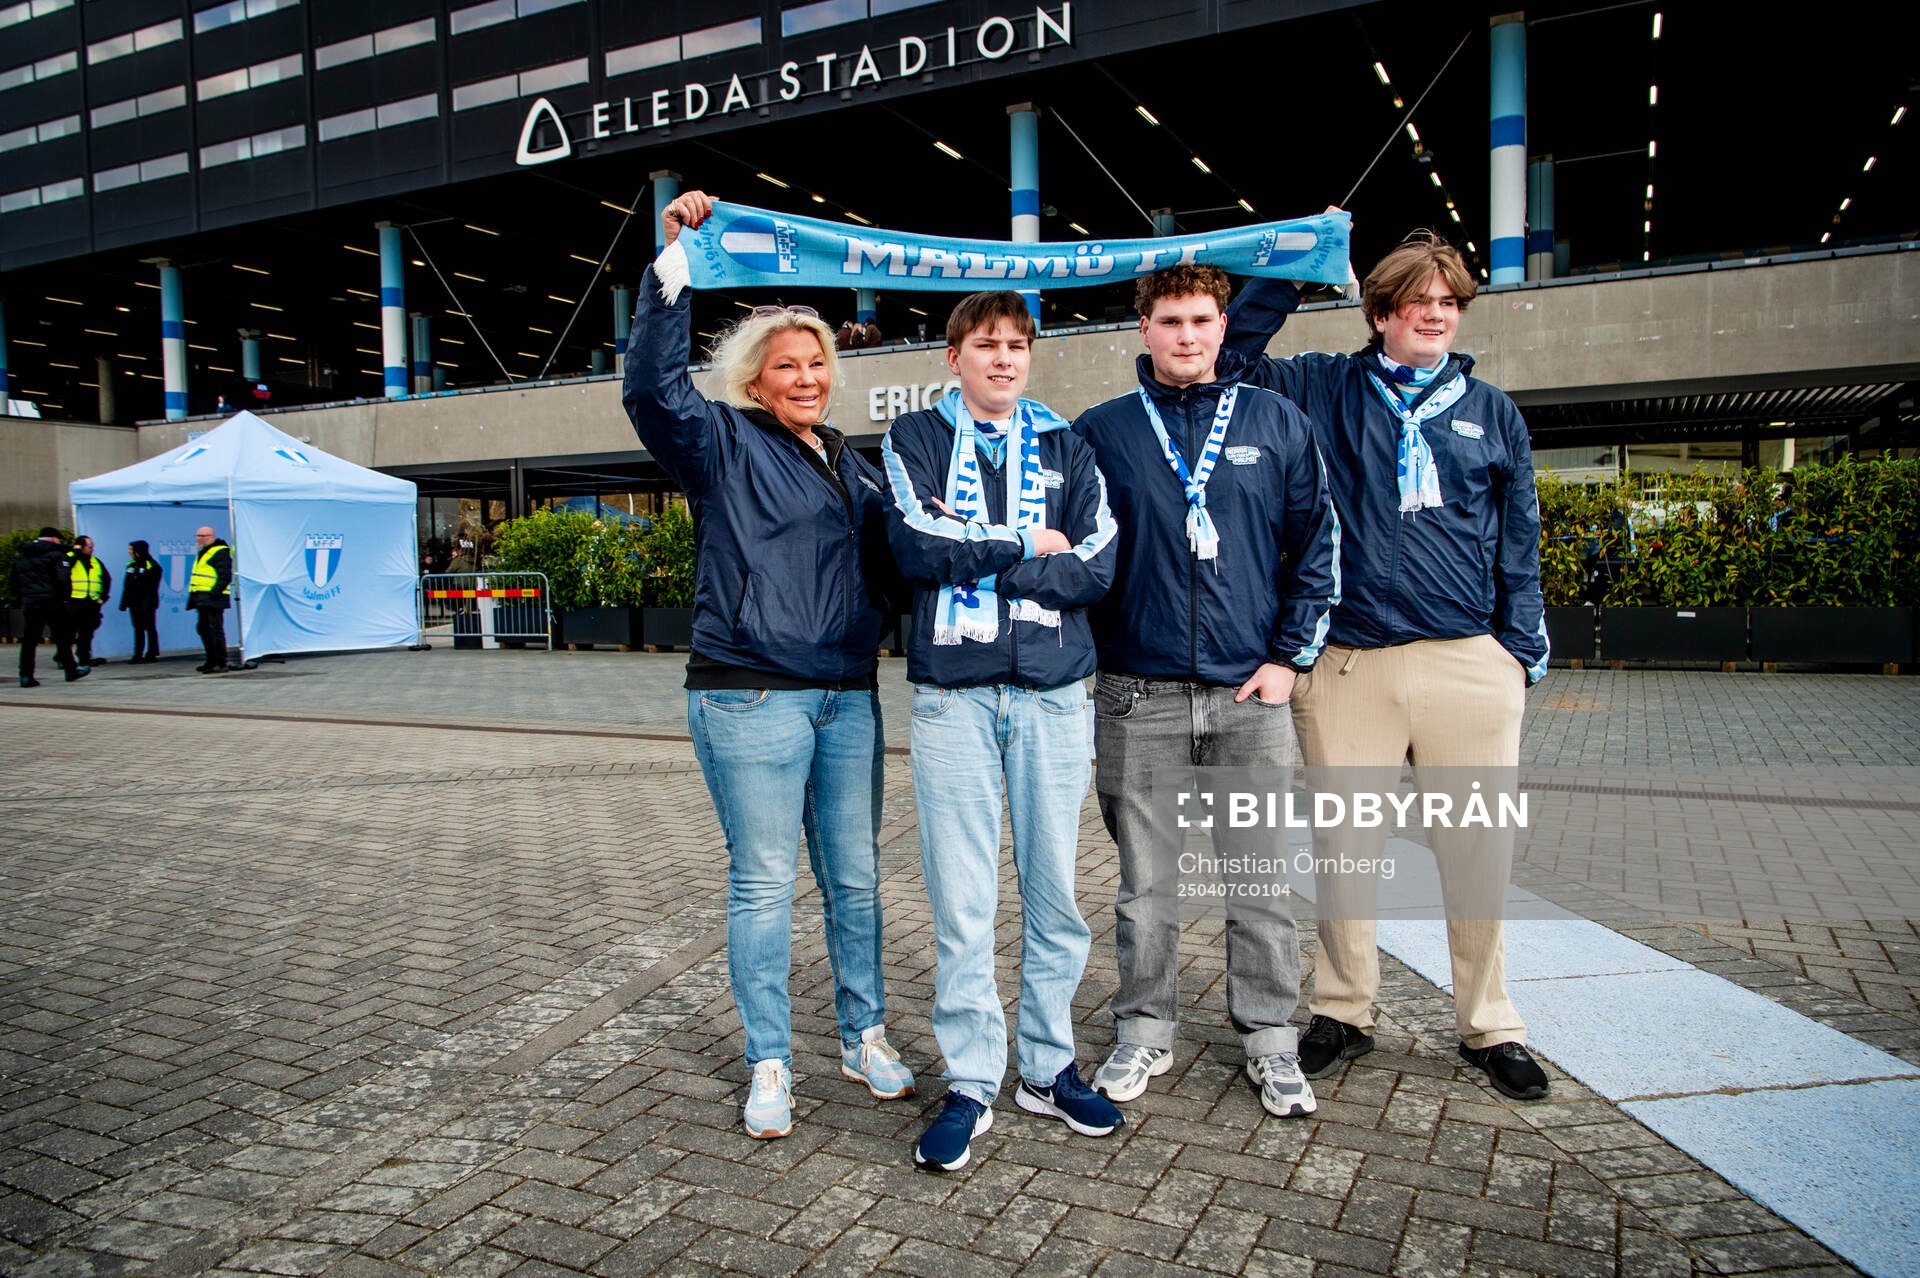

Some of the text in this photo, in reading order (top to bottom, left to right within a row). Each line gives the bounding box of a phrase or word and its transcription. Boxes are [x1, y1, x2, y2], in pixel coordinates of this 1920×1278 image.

[593, 1, 1072, 138] ELEDA STADION
[841, 235, 1114, 279] MALMÖ
